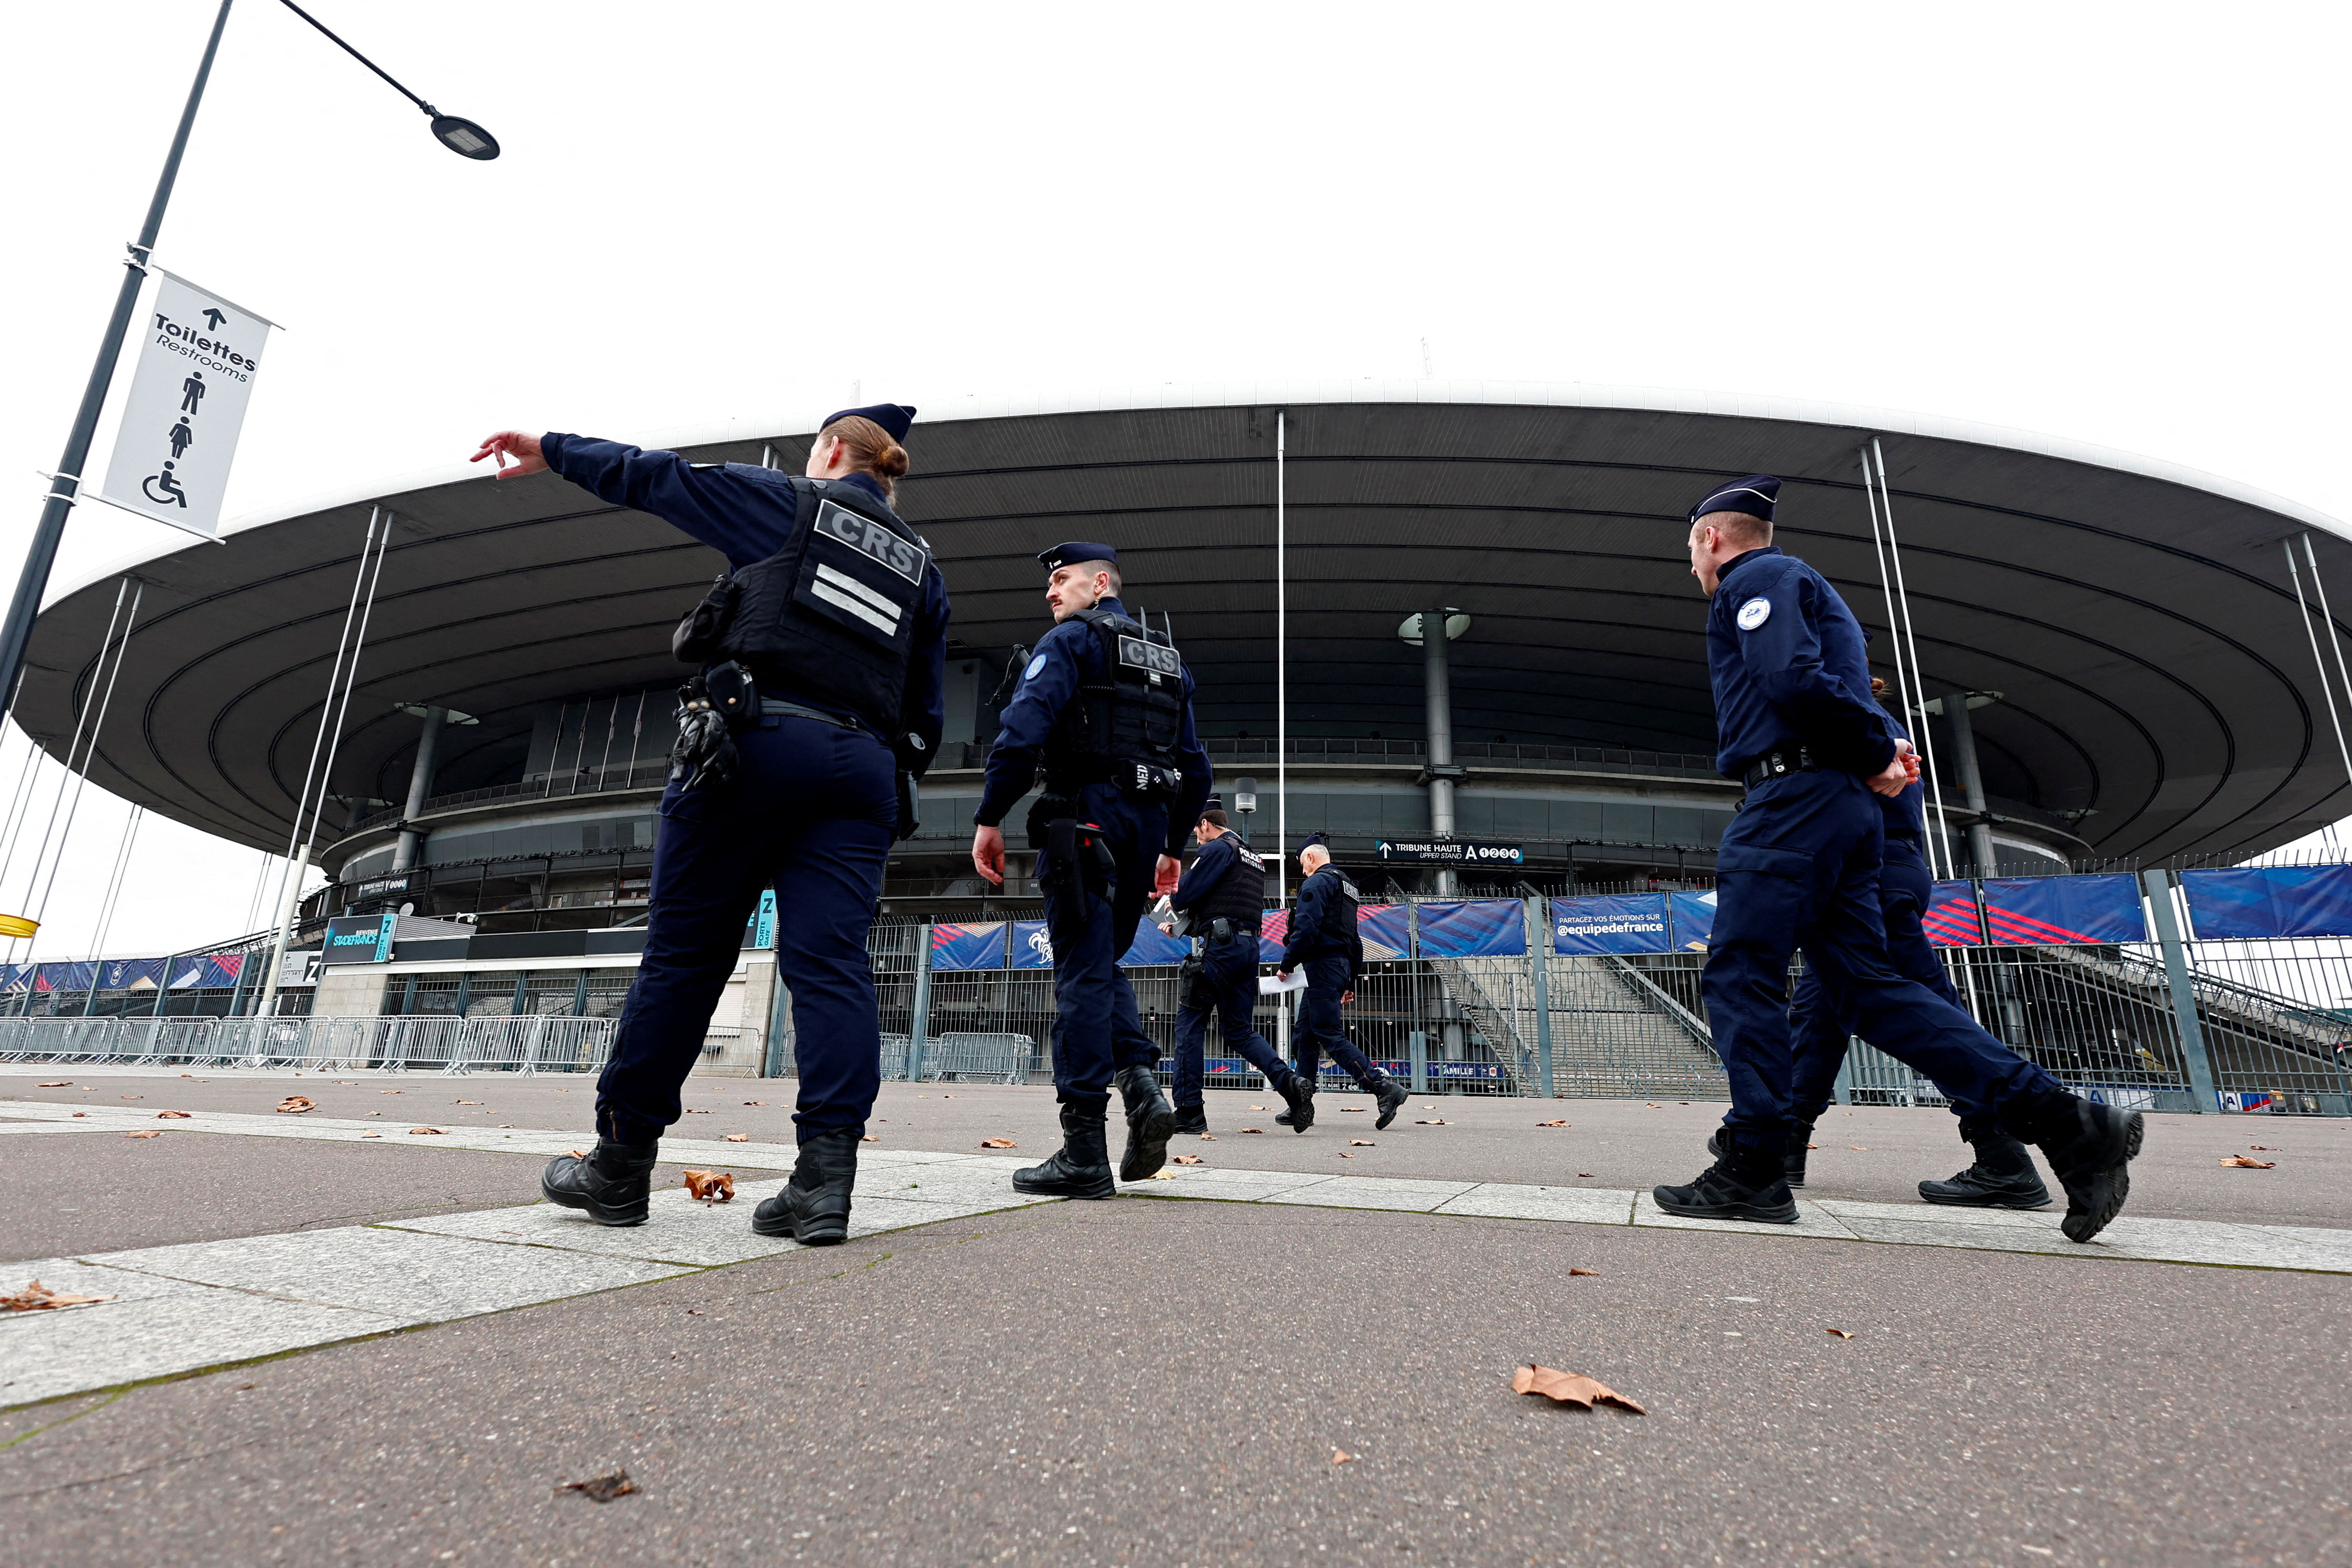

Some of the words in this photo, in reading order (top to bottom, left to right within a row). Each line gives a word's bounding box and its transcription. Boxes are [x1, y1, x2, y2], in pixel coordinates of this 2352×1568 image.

[156, 313, 256, 372] Toilettes
[156, 334, 248, 382] Restrooms
[832, 511, 914, 573] CRS
[1127, 641, 1176, 671] CRS
[1239, 847, 1259, 863] POLICE
[1396, 844, 1431, 852] TRIBUNE
[1465, 845, 1477, 860] A
[1241, 856, 1265, 872] NATIONALE
[385, 880, 390, 891] Y
[1346, 884, 1358, 899] CRS
[762, 898, 773, 914] Z
[383, 920, 391, 933] Z
[1557, 922, 1664, 936] @equipedefrance
[305, 961, 319, 982] Z
[2090, 1090, 2104, 1104] A
[2227, 1096, 2236, 1105] A
